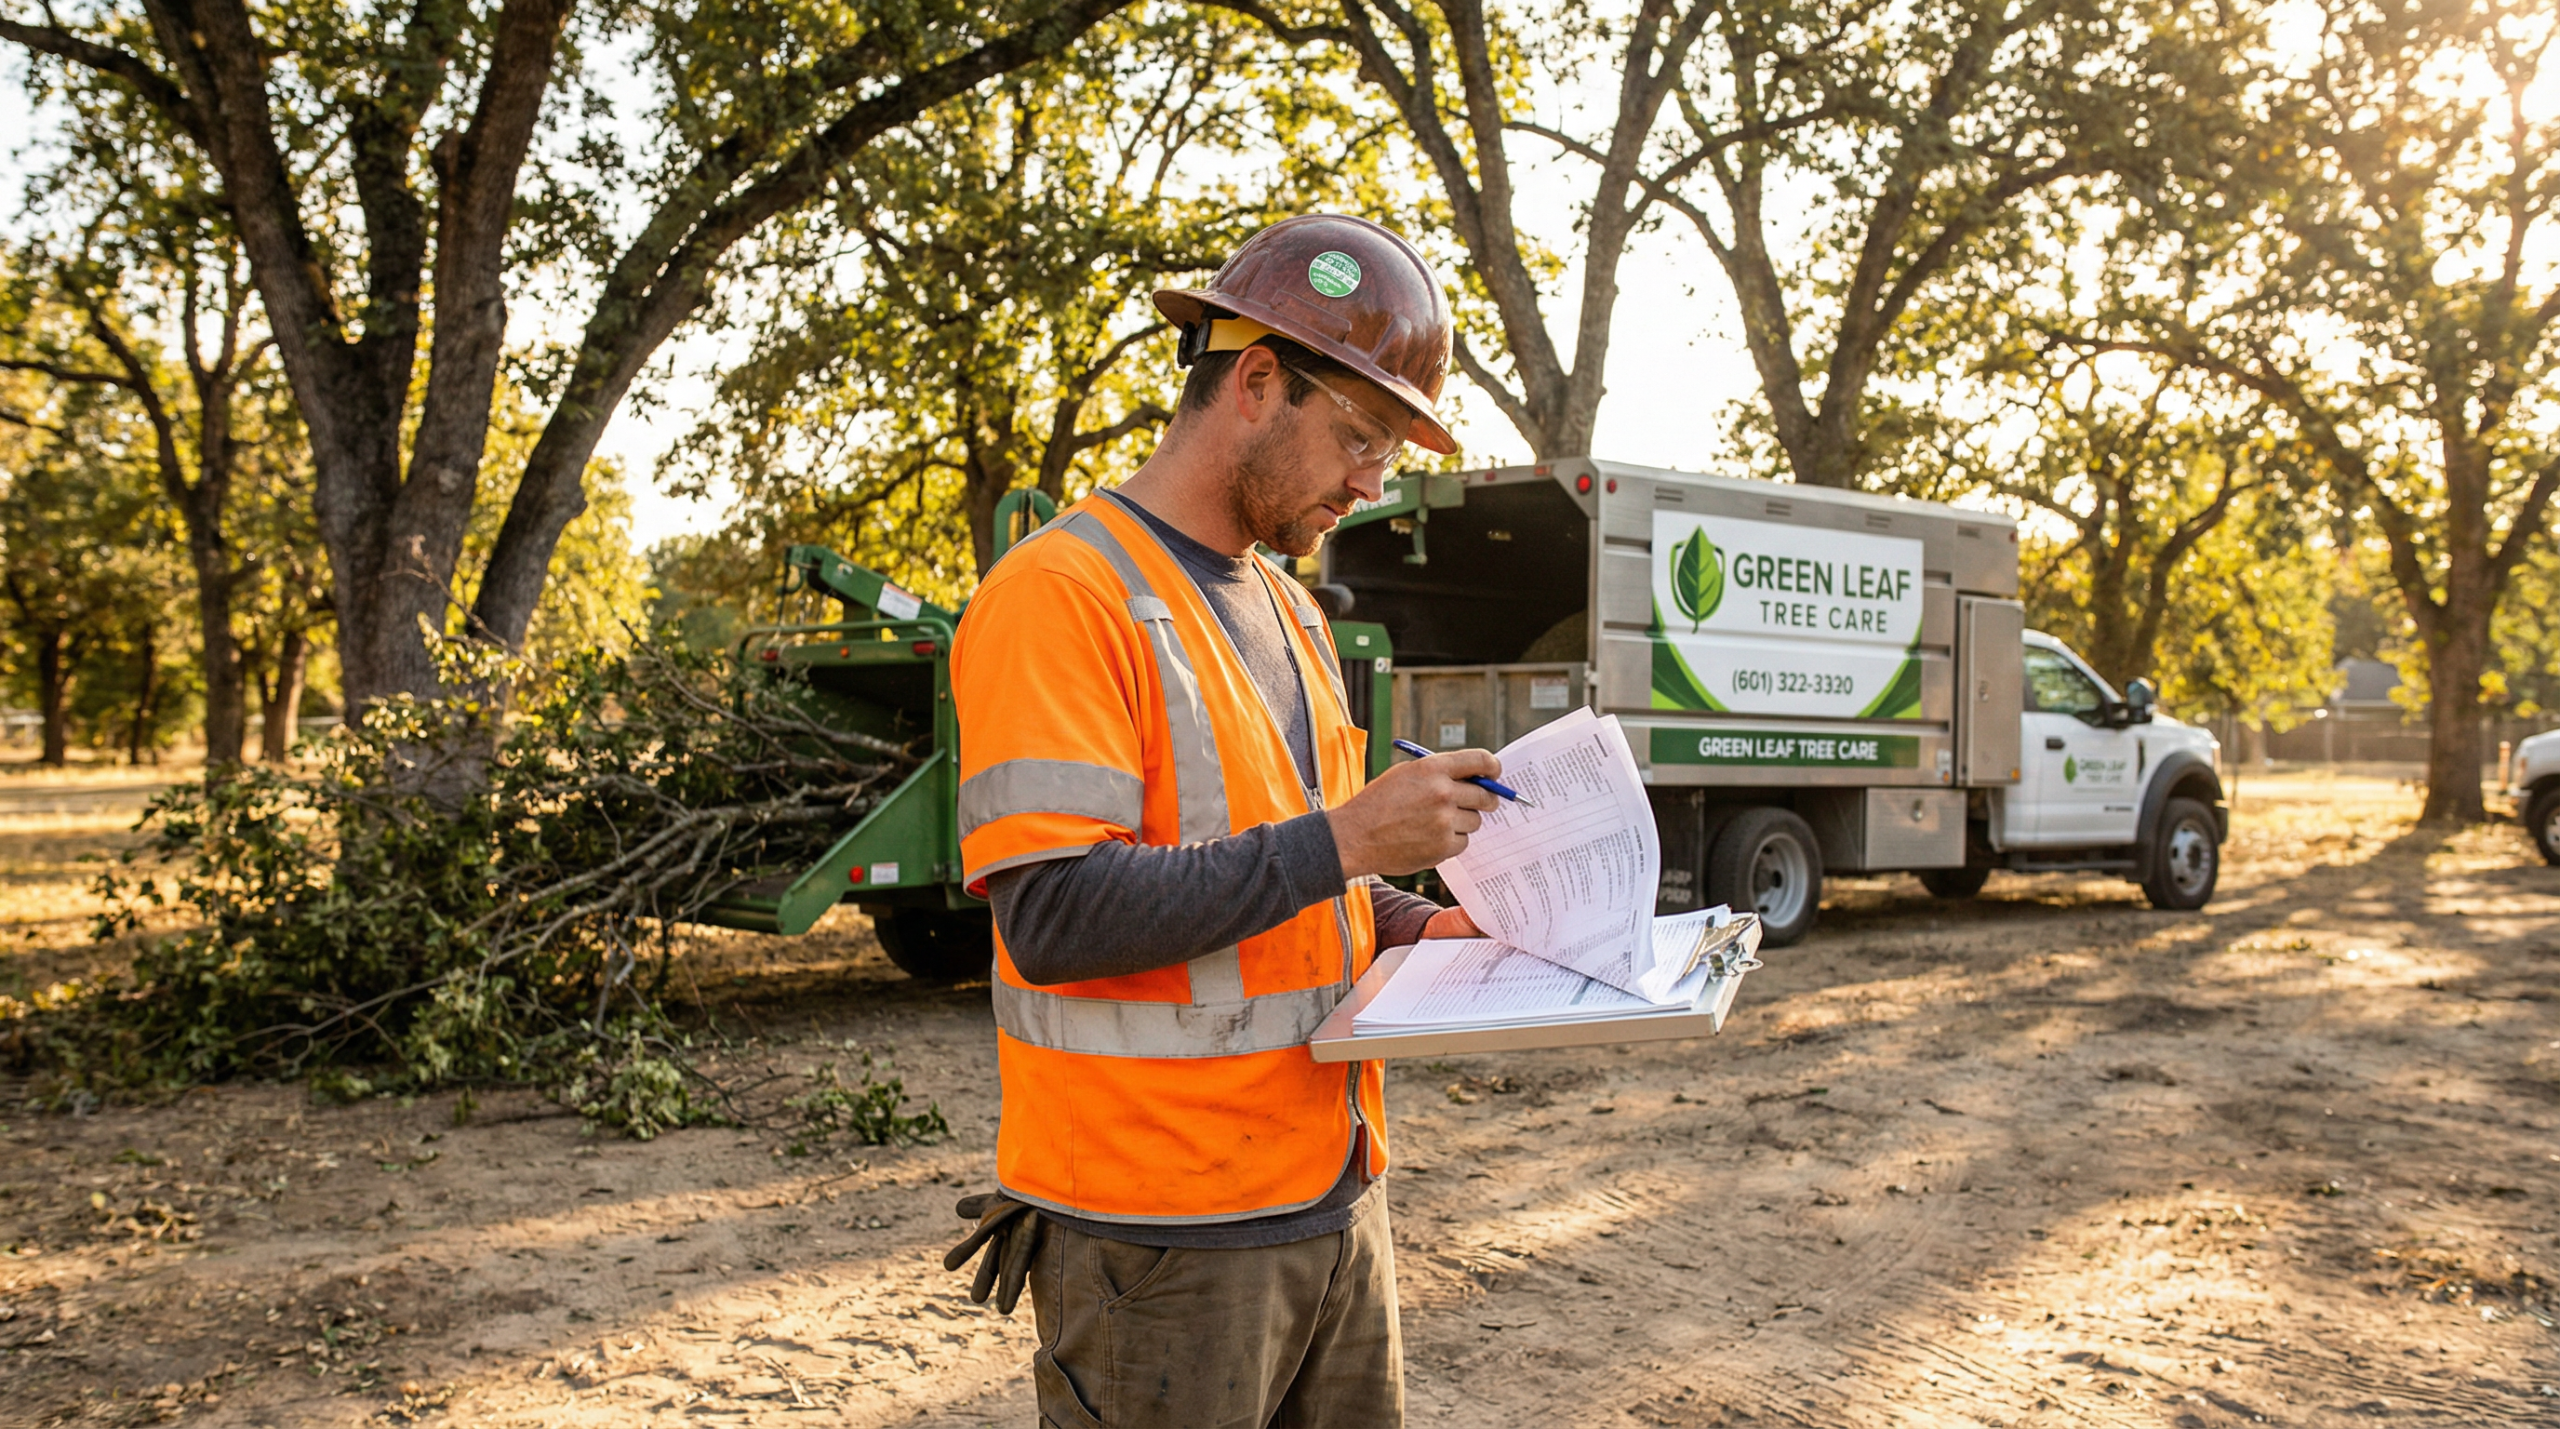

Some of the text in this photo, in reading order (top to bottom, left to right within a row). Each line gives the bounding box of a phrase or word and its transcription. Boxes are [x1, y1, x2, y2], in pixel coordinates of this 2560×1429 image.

[1733, 552, 1911, 602] GREEN LEAF
[1760, 601, 1887, 633] TREE CARE
[1732, 669, 1773, 695] (601)
[1699, 737, 1878, 760] GREEN LEAF TREE CARE
